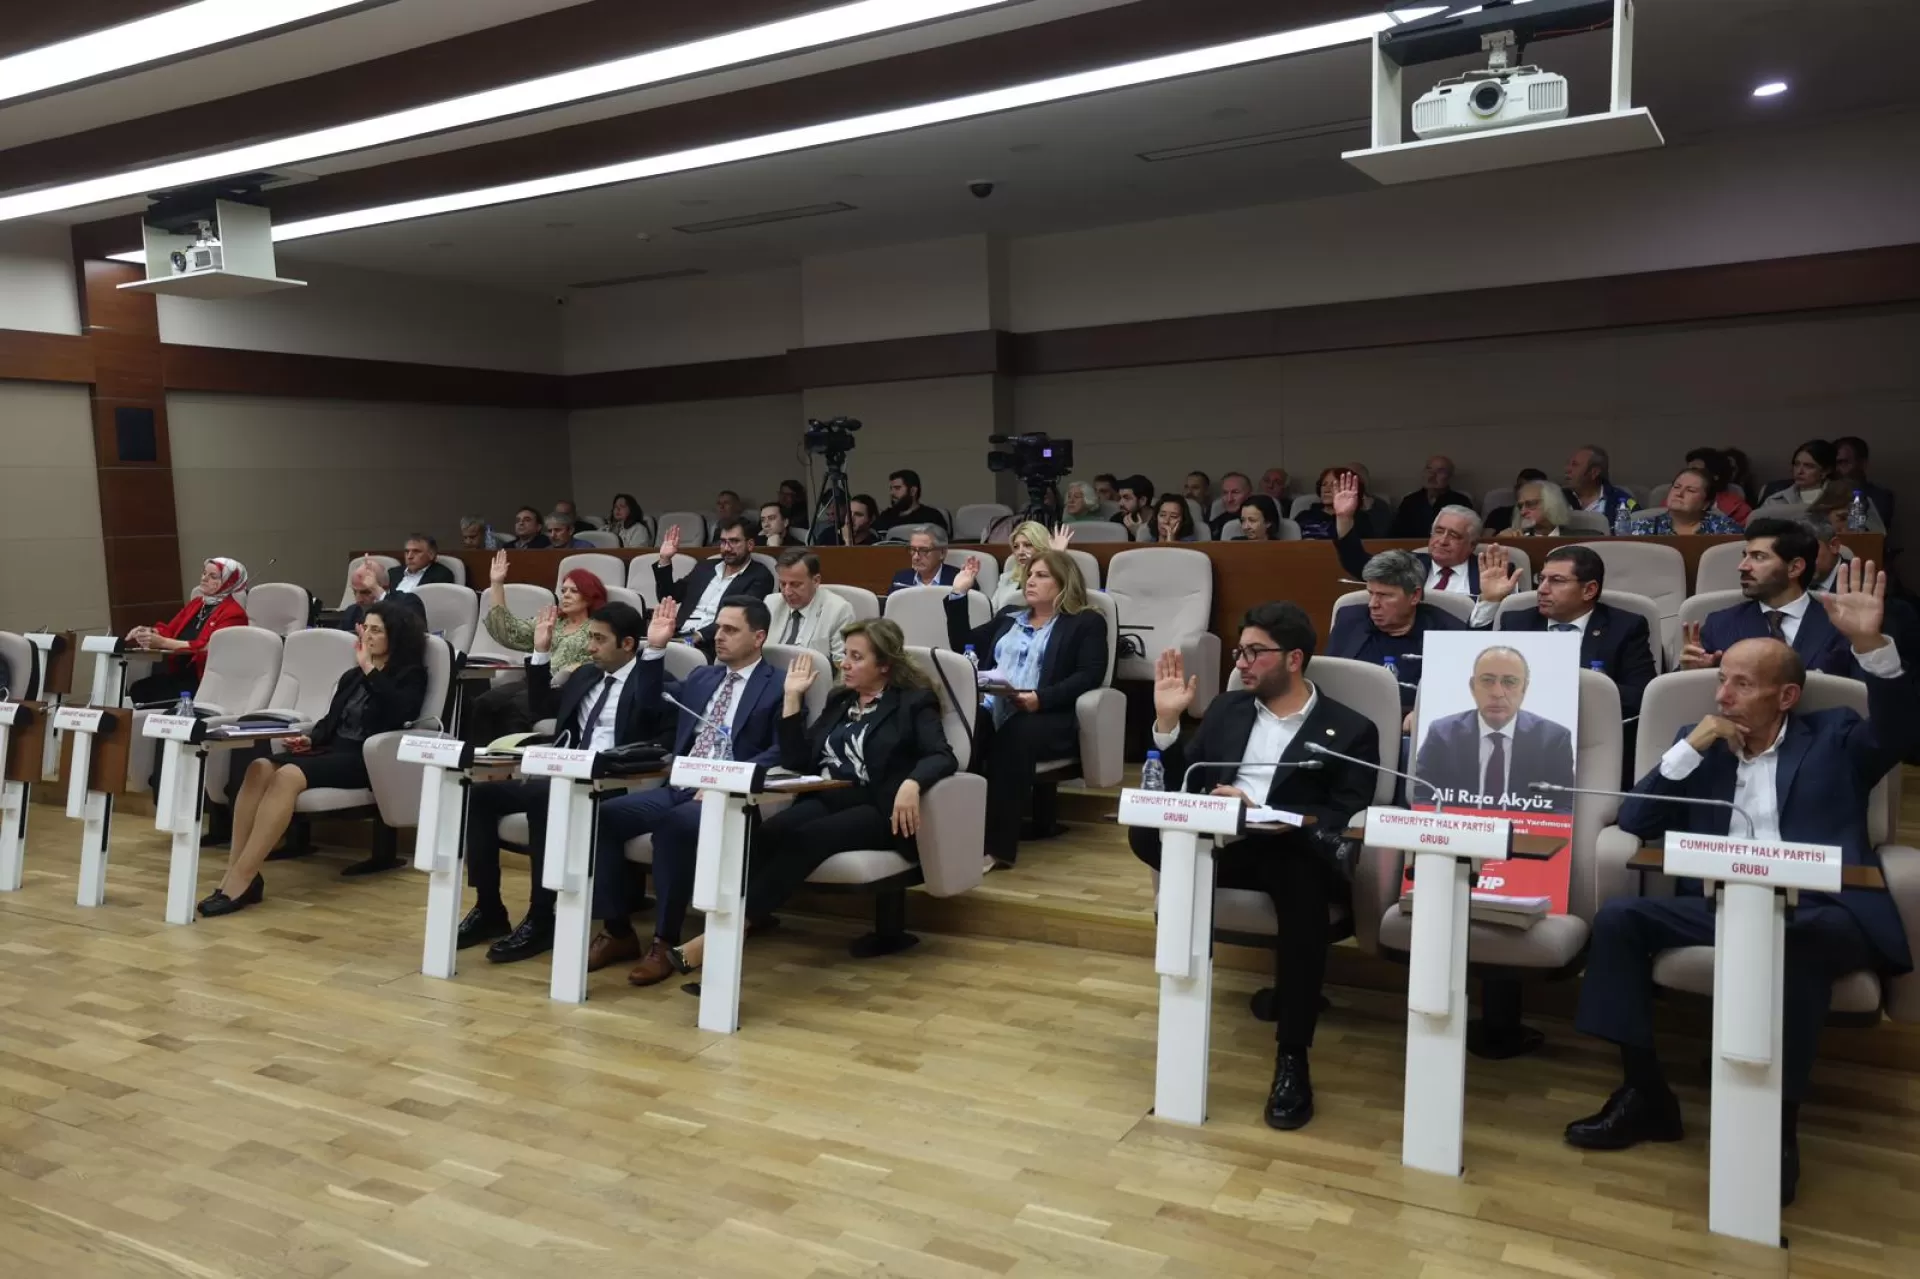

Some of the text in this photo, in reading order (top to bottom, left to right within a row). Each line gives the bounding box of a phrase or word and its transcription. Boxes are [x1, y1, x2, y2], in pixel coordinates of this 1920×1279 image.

[1130, 794, 1176, 807] CUMHURİYET
[1178, 799, 1198, 808] HALK
[1431, 788, 1553, 811] Ali Rıza Akyüz
[1163, 812, 1189, 823] GRUBU
[1379, 814, 1495, 833] CUMHURİYET HALK PARTİSİ
[1420, 833, 1450, 845] GRUBU
[1679, 839, 1826, 863] CUMHURİYET HALK PARTİSİ
[1731, 862, 1769, 877] GRUBU
[1476, 875, 1505, 890] HP
